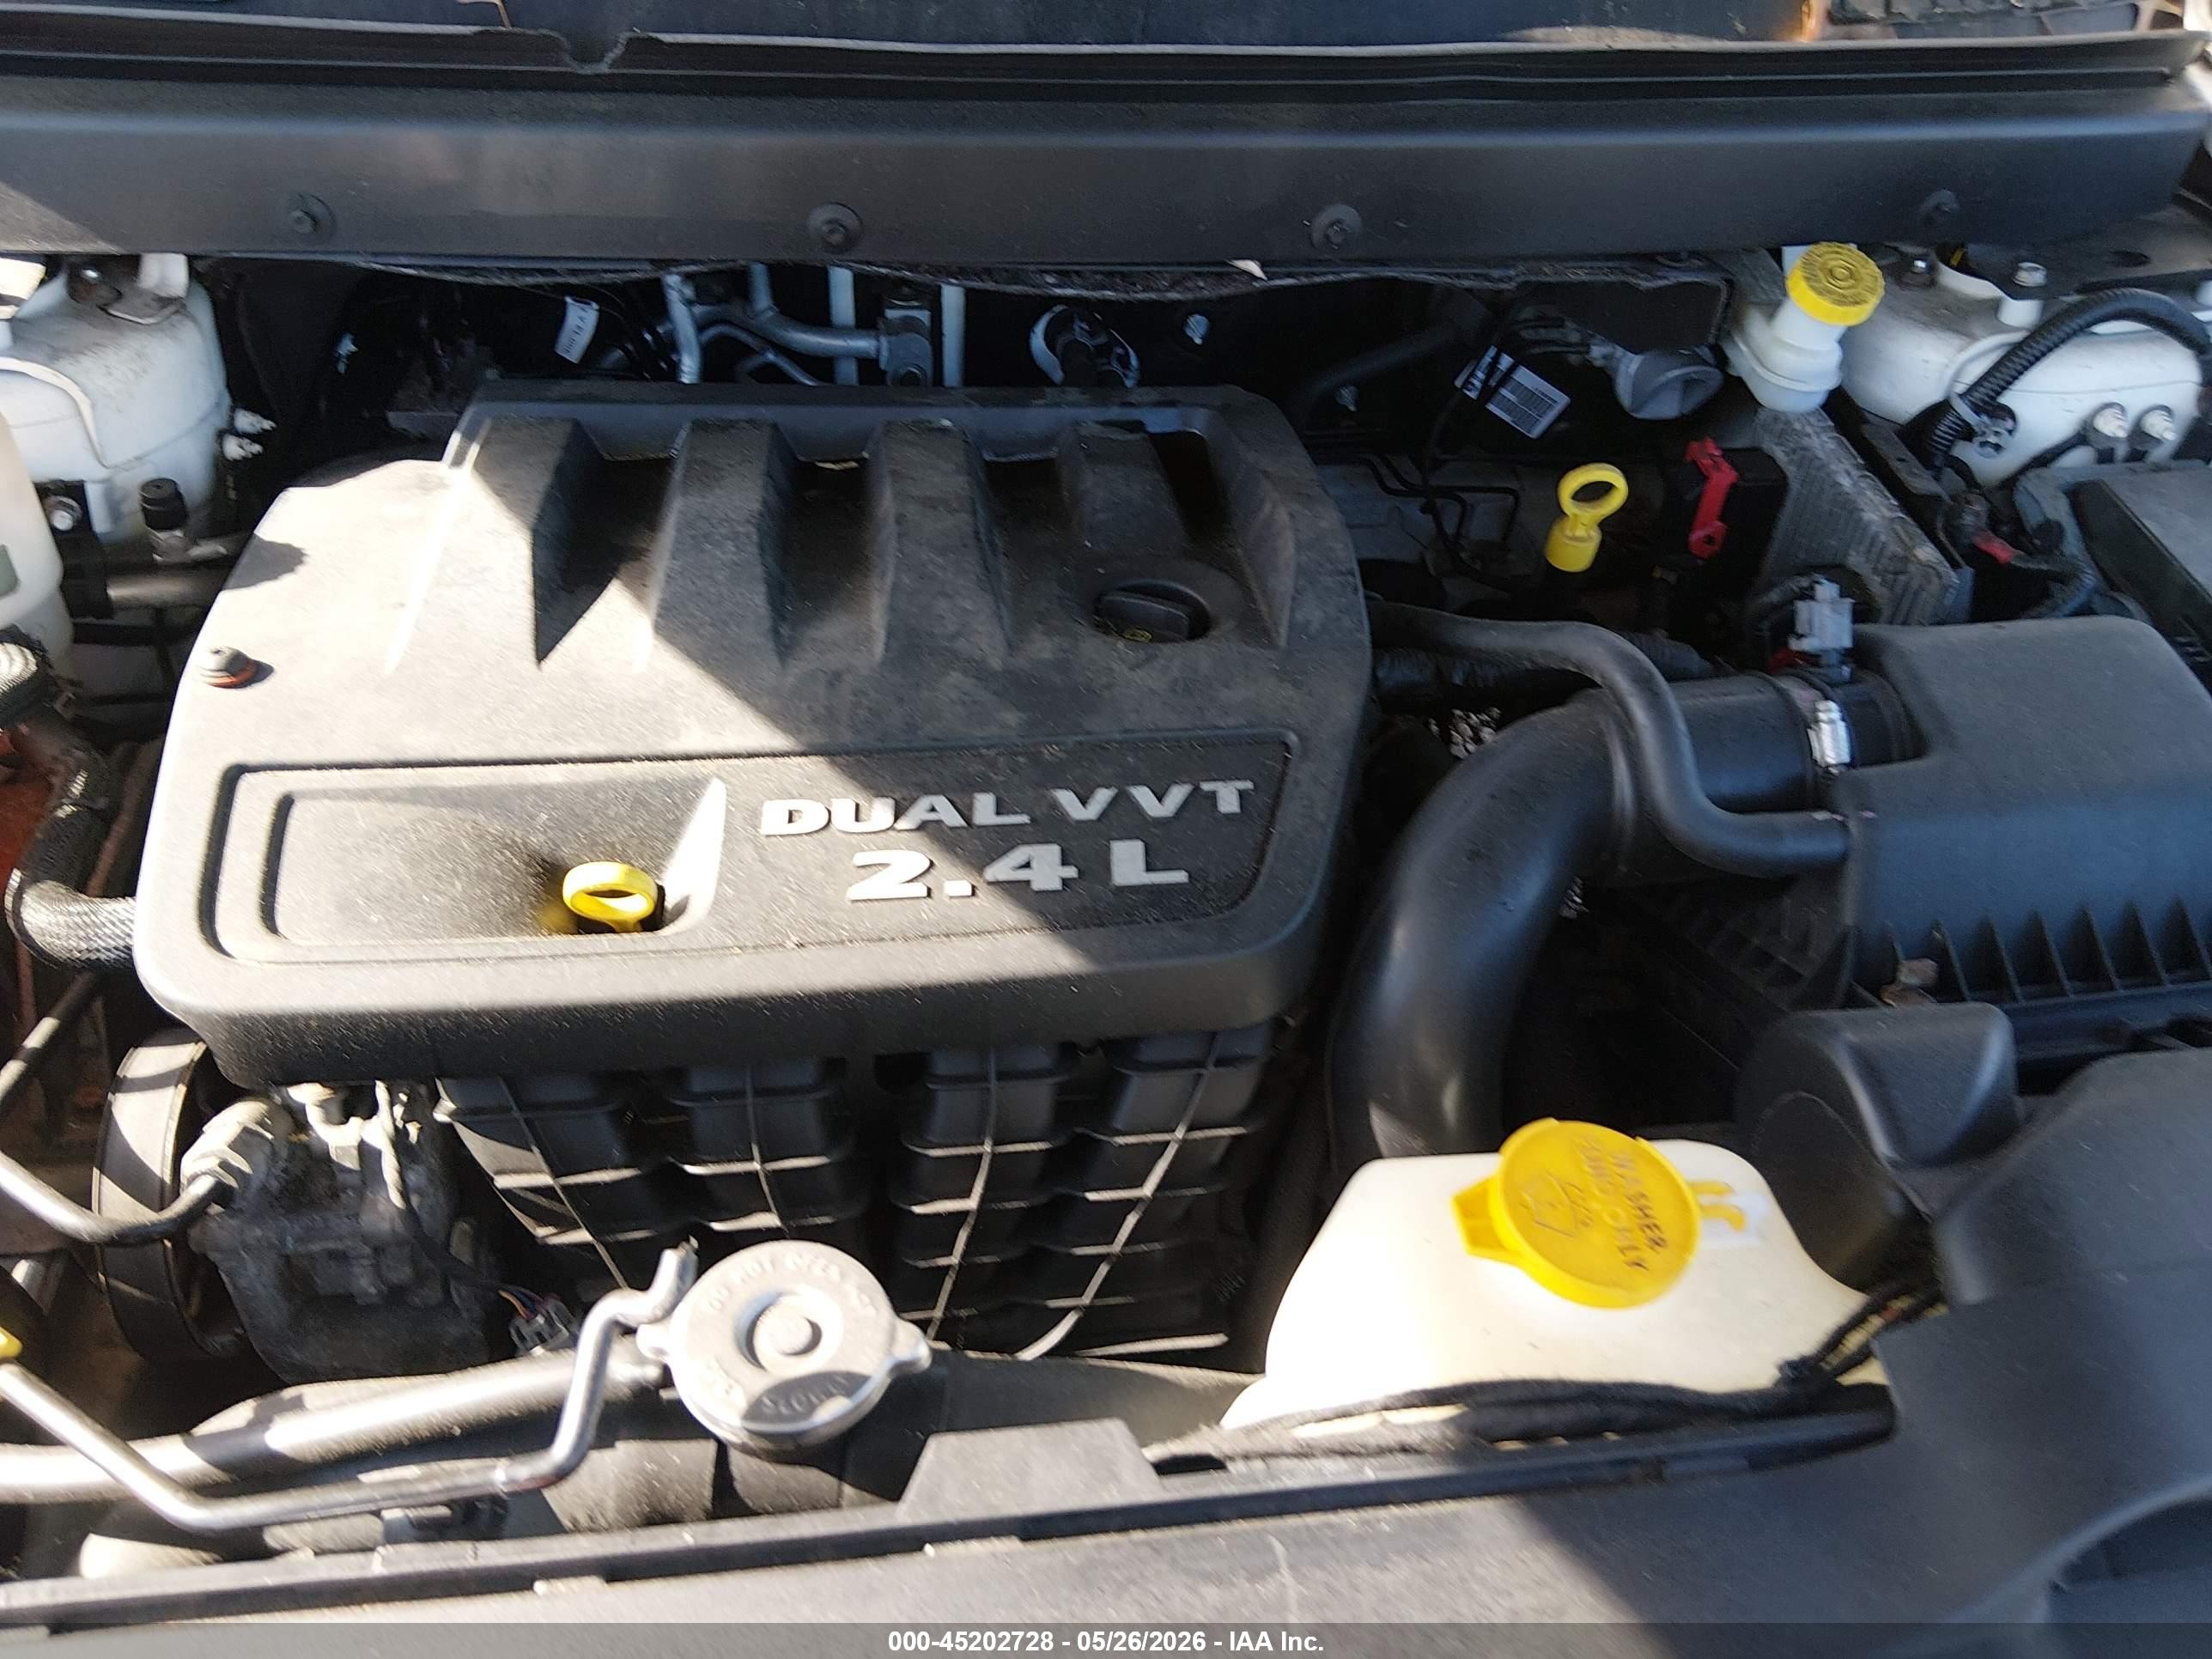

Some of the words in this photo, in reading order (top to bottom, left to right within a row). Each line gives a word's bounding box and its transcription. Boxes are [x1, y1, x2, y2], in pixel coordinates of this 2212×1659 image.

[759, 793, 1030, 836] DUAL
[1051, 780, 1254, 822] VVT
[847, 843, 1079, 901] 2.4
[1109, 838, 1189, 886] L
[1607, 1148, 1668, 1255] WASHER
[1601, 1206, 1650, 1272] ONLY
